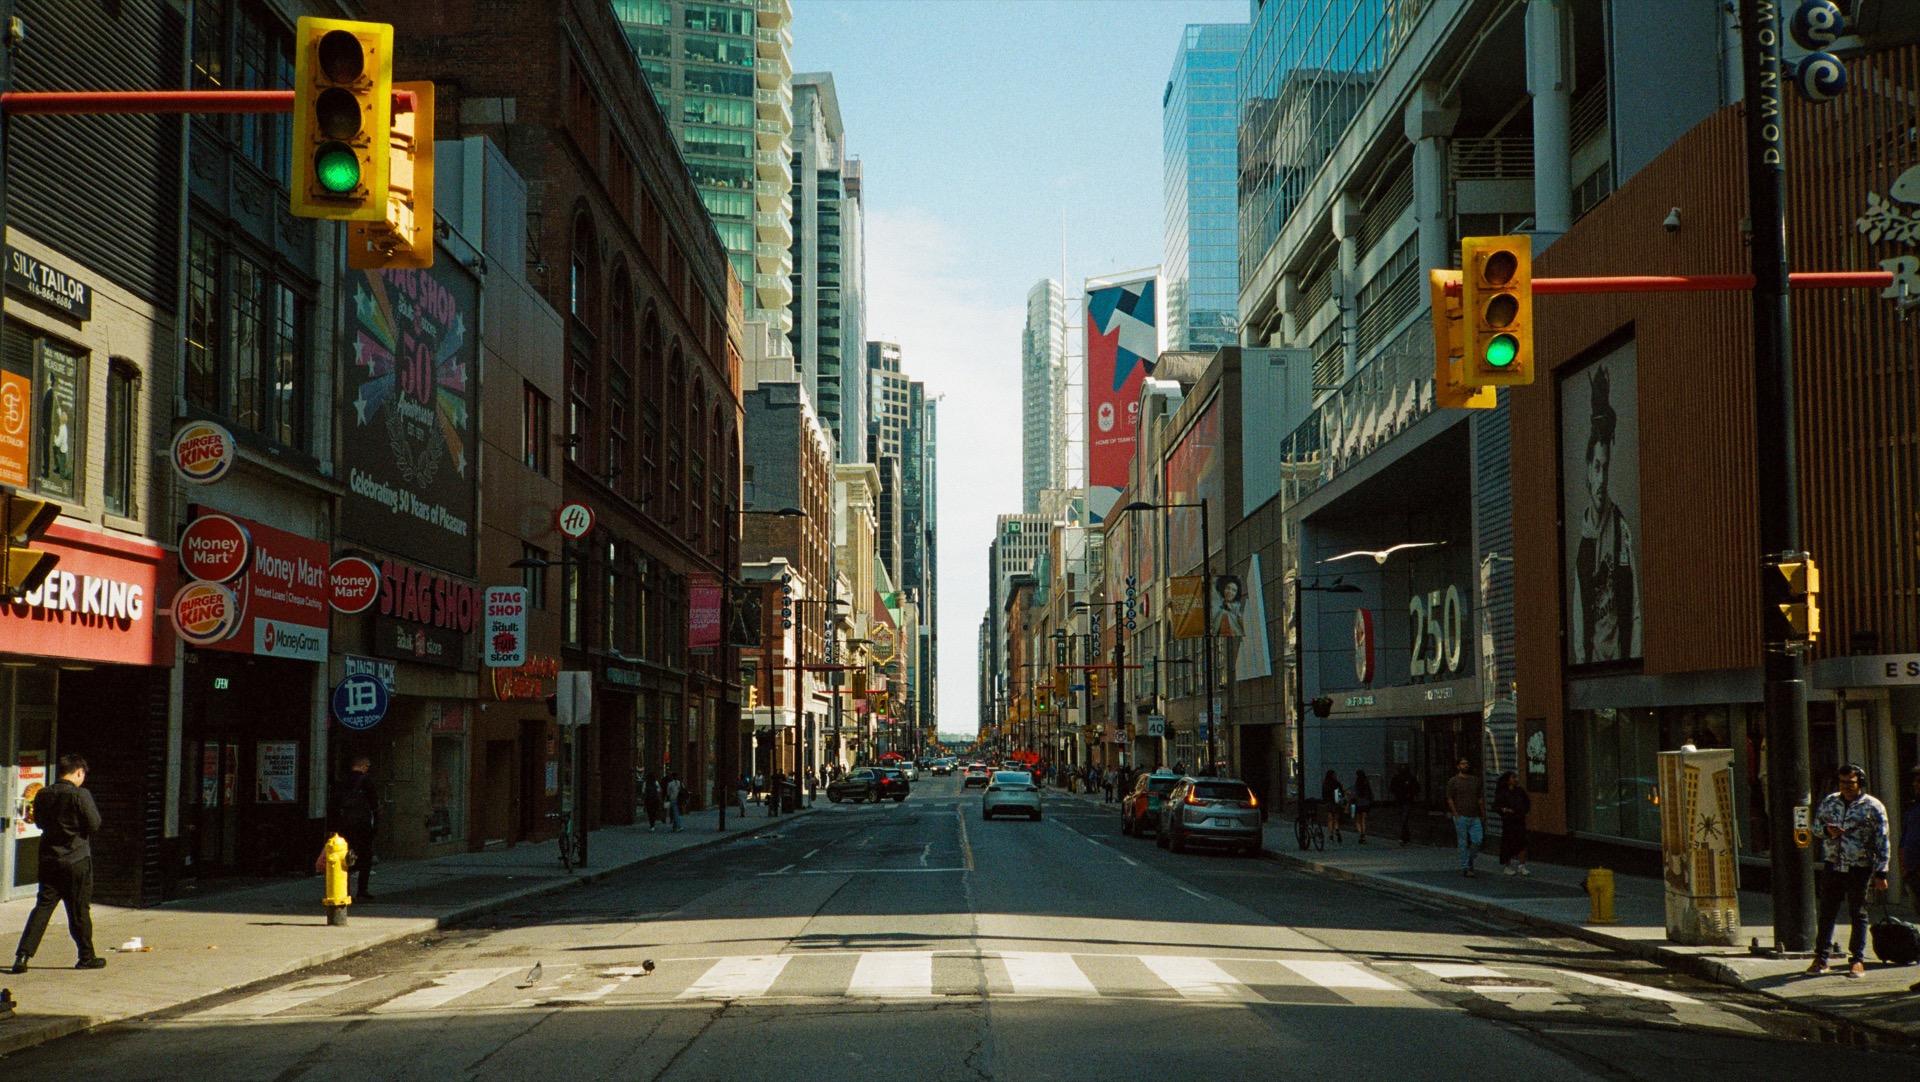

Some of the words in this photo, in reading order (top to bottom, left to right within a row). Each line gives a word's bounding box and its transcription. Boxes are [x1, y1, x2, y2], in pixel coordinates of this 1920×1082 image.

[13, 252, 37, 282] SILK
[40, 264, 84, 305] TAILOR
[420, 270, 456, 330] SHOP
[401, 332, 432, 404] 50
[179, 434, 223, 453] BURGER
[180, 445, 224, 468] KING
[351, 467, 398, 514] Celebrating
[399, 488, 410, 513] 50
[411, 493, 430, 521] Years
[431, 504, 440, 525] of
[440, 506, 467, 537] Pleasure
[564, 508, 586, 530] Hi
[1009, 523, 1020, 533] TD
[188, 537, 239, 553] Money
[193, 551, 229, 564] Mart
[255, 545, 295, 588] Money
[298, 557, 324, 589] Mart
[331, 575, 372, 589] Money
[82, 575, 143, 621] KING
[335, 587, 364, 598] Mart
[381, 560, 432, 625] STAG
[434, 576, 480, 634] SHOP
[490, 592, 521, 603] STAG
[180, 594, 223, 614] BURGER
[488, 605, 522, 616] SHOP
[181, 603, 225, 628] KING
[492, 622, 519, 632] adult
[1409, 584, 1462, 676] 250
[276, 630, 319, 653] MoneyGram
[490, 653, 519, 661] store
[214, 678, 228, 689] OPEN
[1149, 724, 1164, 733] 40
